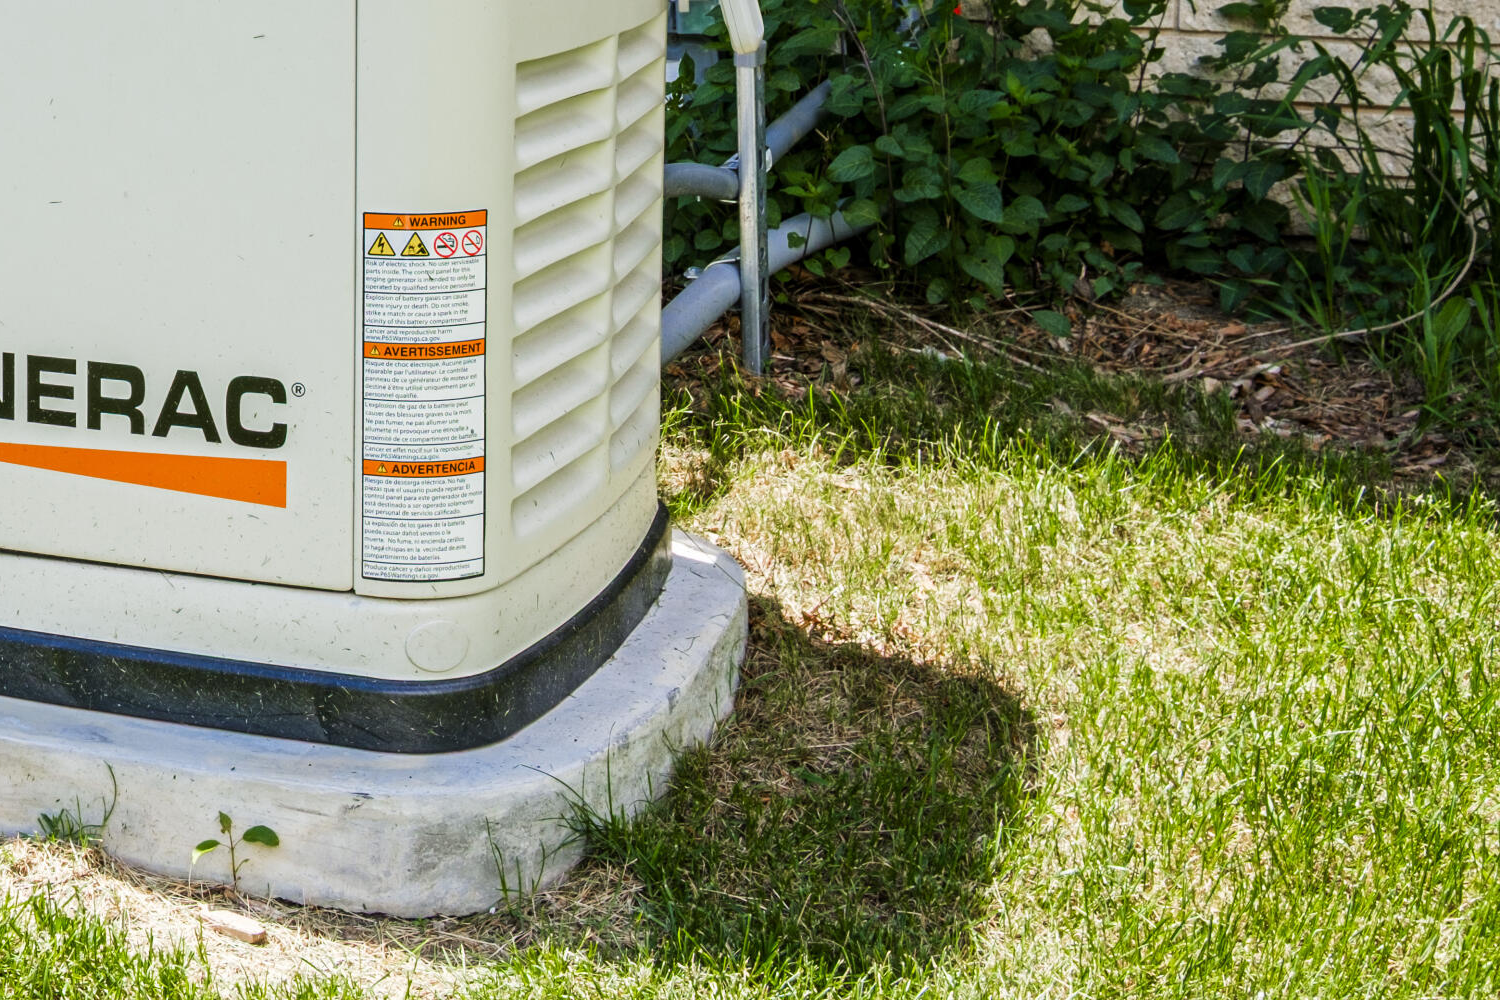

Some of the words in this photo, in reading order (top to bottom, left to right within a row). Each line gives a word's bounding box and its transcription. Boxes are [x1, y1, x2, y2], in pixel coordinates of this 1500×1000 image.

[409, 215, 467, 227] WARNING
[384, 342, 482, 357] AVERTISSEMENT
[392, 461, 475, 474] ADVERTENCIA
